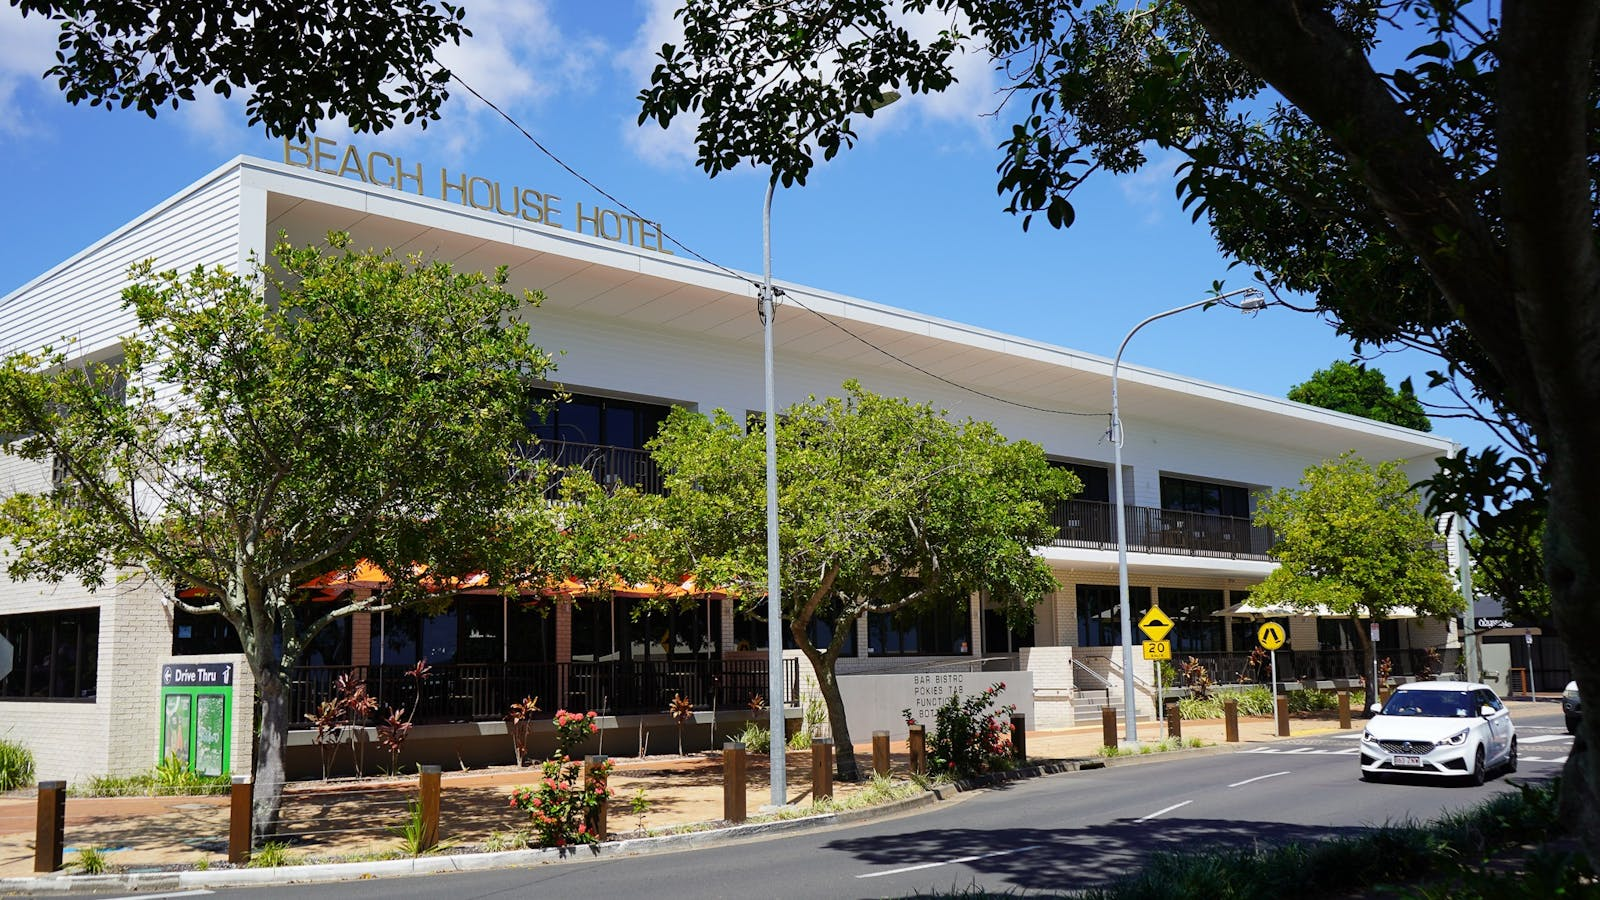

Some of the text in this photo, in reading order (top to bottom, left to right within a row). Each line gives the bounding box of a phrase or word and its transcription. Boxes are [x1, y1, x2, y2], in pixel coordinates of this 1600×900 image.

[283, 133, 673, 255] BEACH HOUSE HOTEL
[1149, 642, 1165, 653] 20
[175, 668, 217, 682] Drive Thru
[914, 674, 963, 684] BAR BISTRO
[914, 685, 963, 696] POKIES TAB
[916, 697, 952, 707] FUNCTIO
